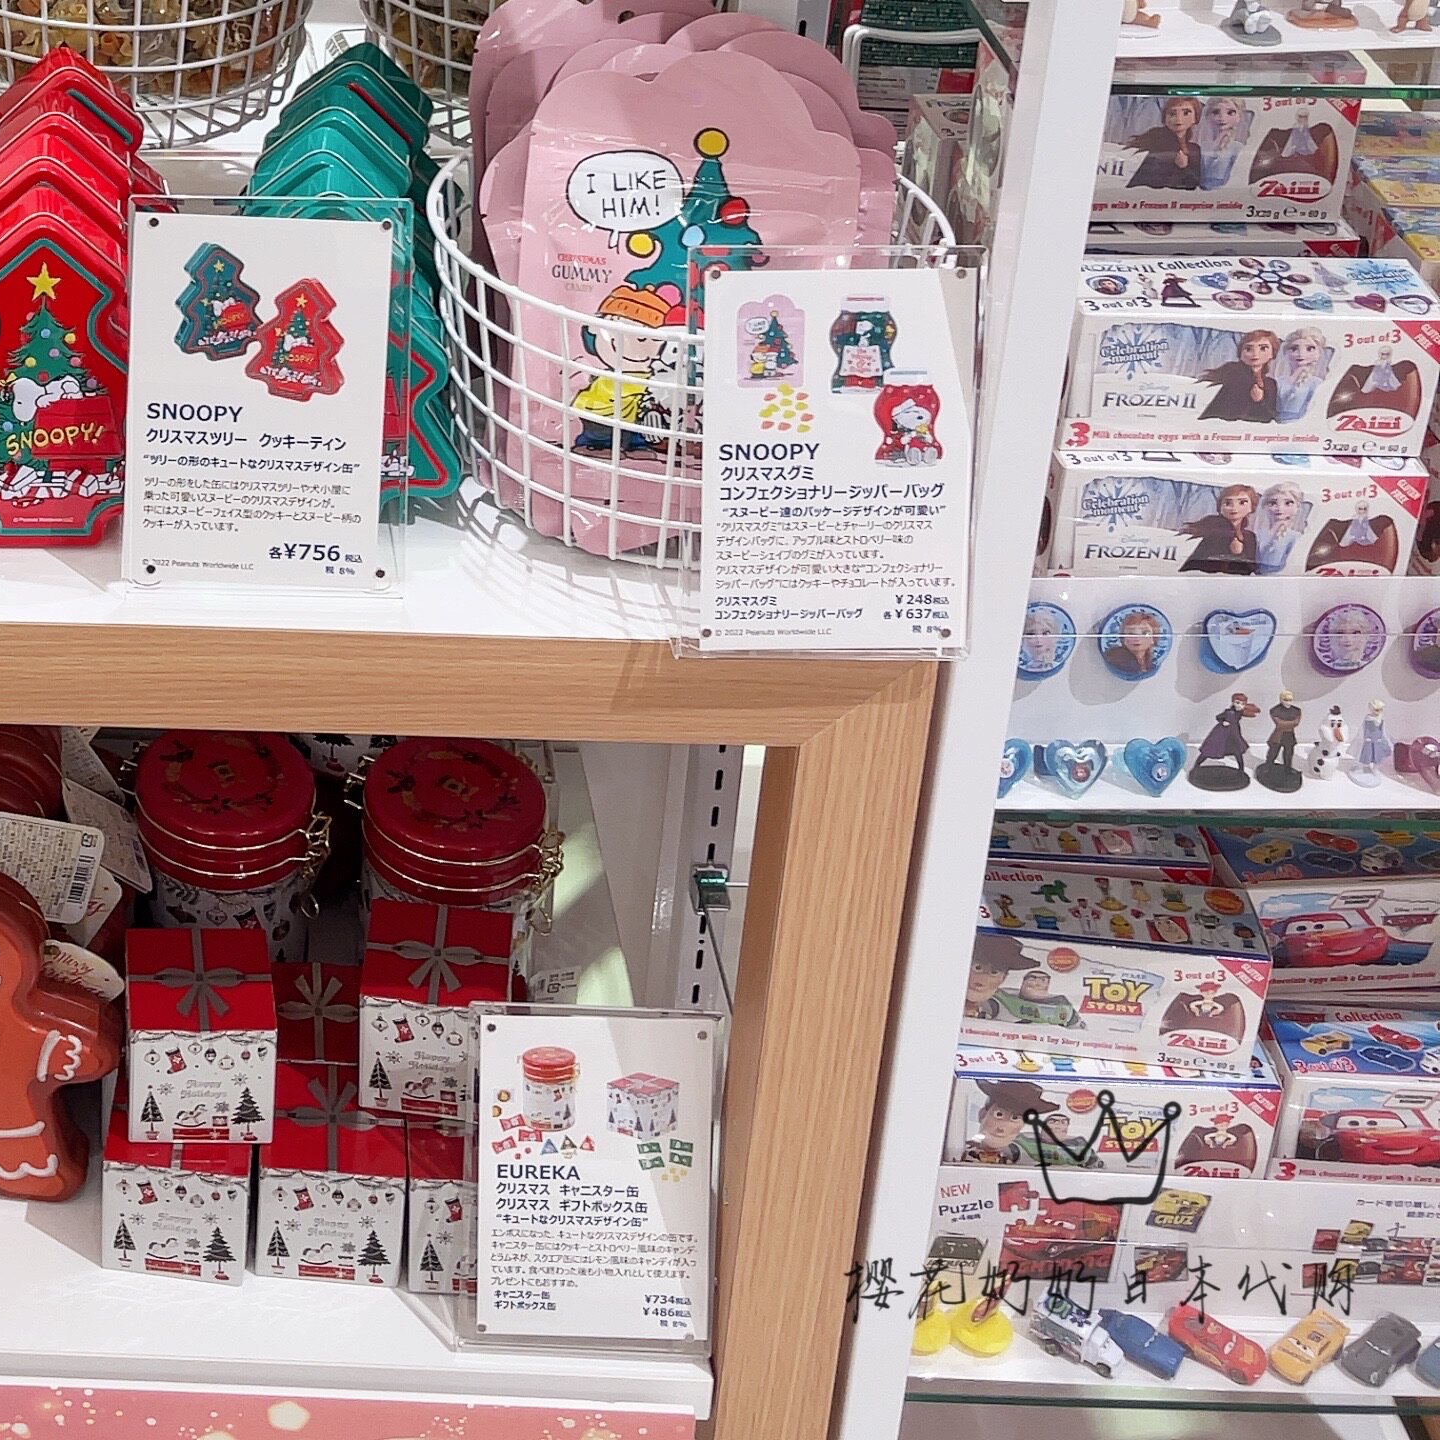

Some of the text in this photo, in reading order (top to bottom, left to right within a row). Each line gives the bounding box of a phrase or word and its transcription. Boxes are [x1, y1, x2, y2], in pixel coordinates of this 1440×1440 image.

[587, 170, 667, 194] I LIKE
[601, 195, 661, 218] HIM!
[1157, 258, 1233, 271] Collection
[552, 265, 612, 283] GUMMY
[1099, 339, 1169, 358] Celebration
[1102, 393, 1197, 408] FROZEN II
[147, 403, 243, 422] SNOOPY
[6, 422, 105, 456] SNOOPY!
[146, 428, 347, 451] クリスマスツリー クッキーティン
[718, 443, 820, 461] SNOOPY
[720, 466, 815, 481] クリスマスグミ
[720, 483, 945, 501] コンフェクショナリージッパーバッグ
[1085, 544, 1178, 561] FROZEN II
[715, 596, 778, 606] クリスマスグミ
[1083, 977, 1153, 1002] TOY
[1087, 1001, 1138, 1013] STORY
[1335, 1011, 1403, 1022] Collection
[497, 1164, 580, 1180] EUREKA
[496, 1182, 639, 1198] クリスマス キャニスター缶
[941, 1184, 971, 1198] NEW
[496, 1198, 648, 1214] クリスマス ギフトボックス缶
[938, 1200, 994, 1216] Puzzle
[1154, 1214, 1193, 1226] CRUZ
[494, 1290, 551, 1300] キャニスター缶
